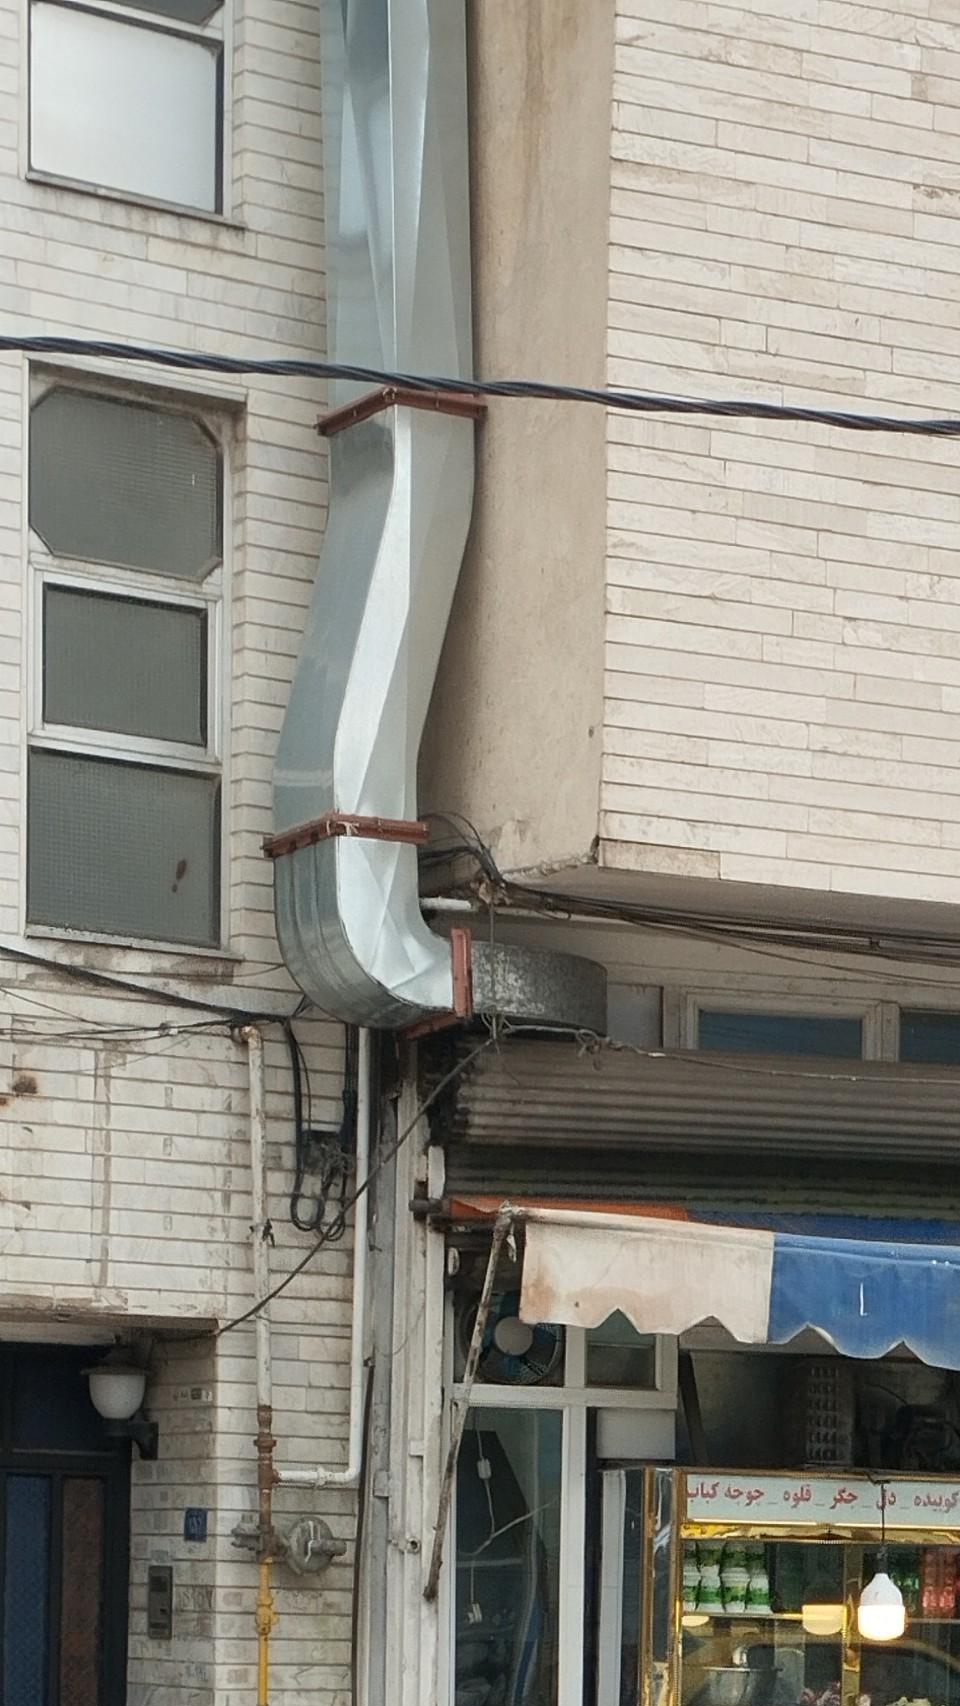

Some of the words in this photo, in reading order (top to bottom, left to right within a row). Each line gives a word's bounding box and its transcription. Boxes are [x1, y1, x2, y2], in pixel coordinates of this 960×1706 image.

[724, 1485, 765, 1507] جوجه
[783, 1484, 811, 1509] قلوه
[829, 1486, 858, 1510] جگر
[914, 1490, 960, 1513] کوبیده
